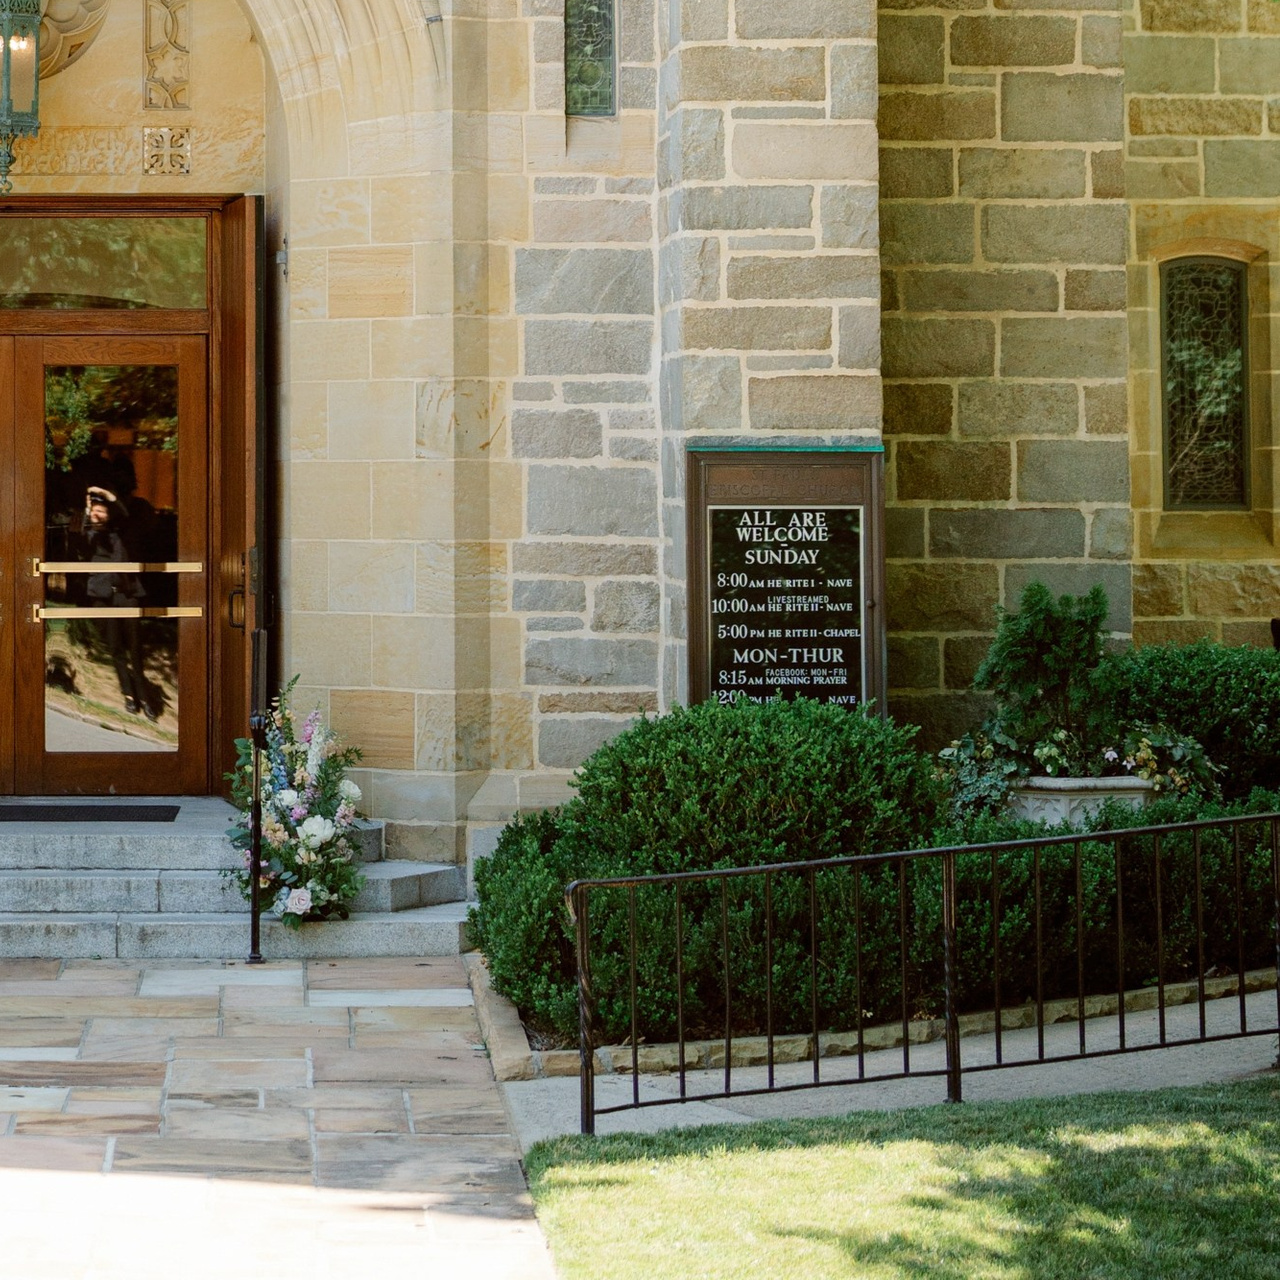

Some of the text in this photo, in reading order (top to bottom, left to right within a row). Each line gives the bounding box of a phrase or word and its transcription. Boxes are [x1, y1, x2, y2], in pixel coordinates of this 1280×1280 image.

[739, 511, 826, 527] ALL ARE
[736, 527, 829, 542] WELCOME
[745, 550, 820, 565] SUNDAY
[717, 572, 748, 588] 8:00
[748, 579, 765, 588] AM
[767, 579, 782, 588] HE
[785, 579, 809, 587] RITE
[827, 579, 853, 587] NAVE
[711, 598, 749, 614] 10:00
[749, 603, 766, 612] AM
[767, 603, 782, 612] HE
[785, 603, 810, 612] RITE
[826, 603, 853, 612] NAVE
[767, 595, 829, 604] LIVESTREAMED
[718, 624, 748, 639] 5:00
[750, 629, 765, 638] PM
[768, 629, 782, 637] HE
[785, 629, 809, 637] RITE
[733, 648, 845, 664] MON-THUR
[719, 670, 848, 685] 8:15 AM MORNING PRAYER
[765, 668, 847, 677] FACEBOOK: MON-FRI
[828, 695, 856, 704] NAVE
